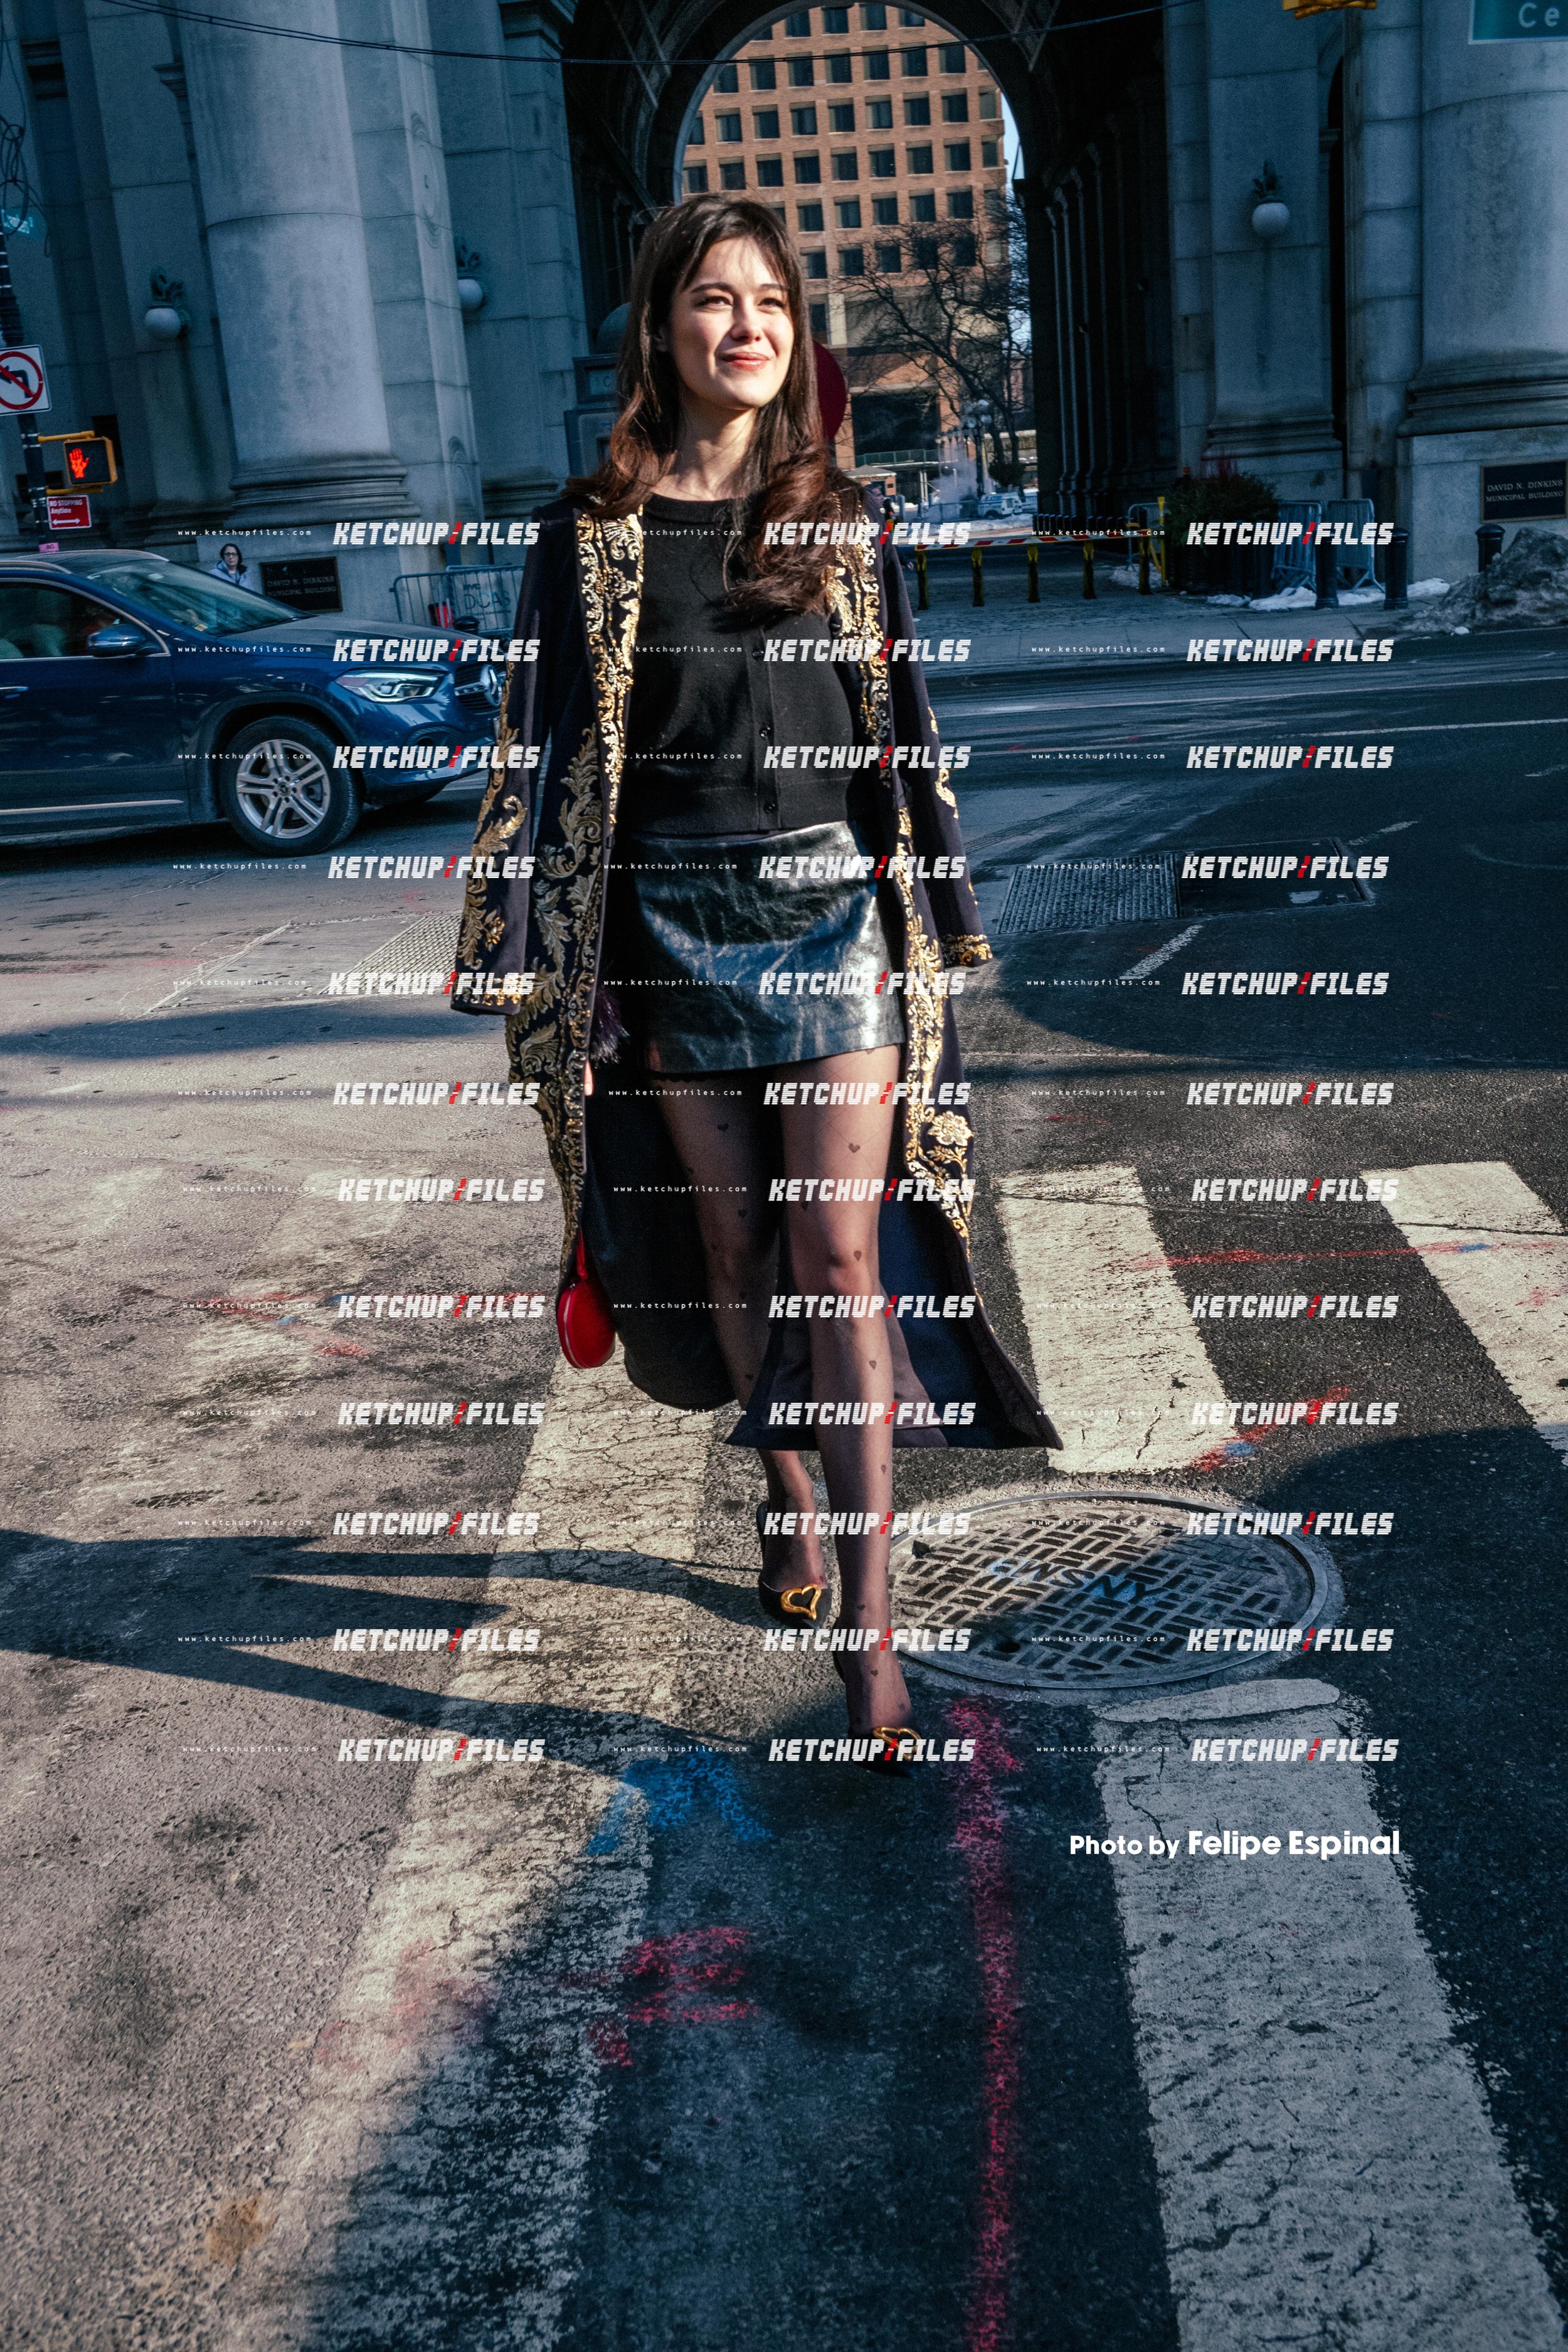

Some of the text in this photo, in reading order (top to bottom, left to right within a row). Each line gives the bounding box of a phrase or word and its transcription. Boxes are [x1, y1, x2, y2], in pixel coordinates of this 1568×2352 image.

[1518, 3, 1559, 28] Ce
[1487, 484, 1513, 492] DAVID
[1528, 480, 1564, 489] DINKINS
[1485, 490, 1564, 502] MUNICIPAL BUILDING
[464, 591, 511, 610] DCAS
